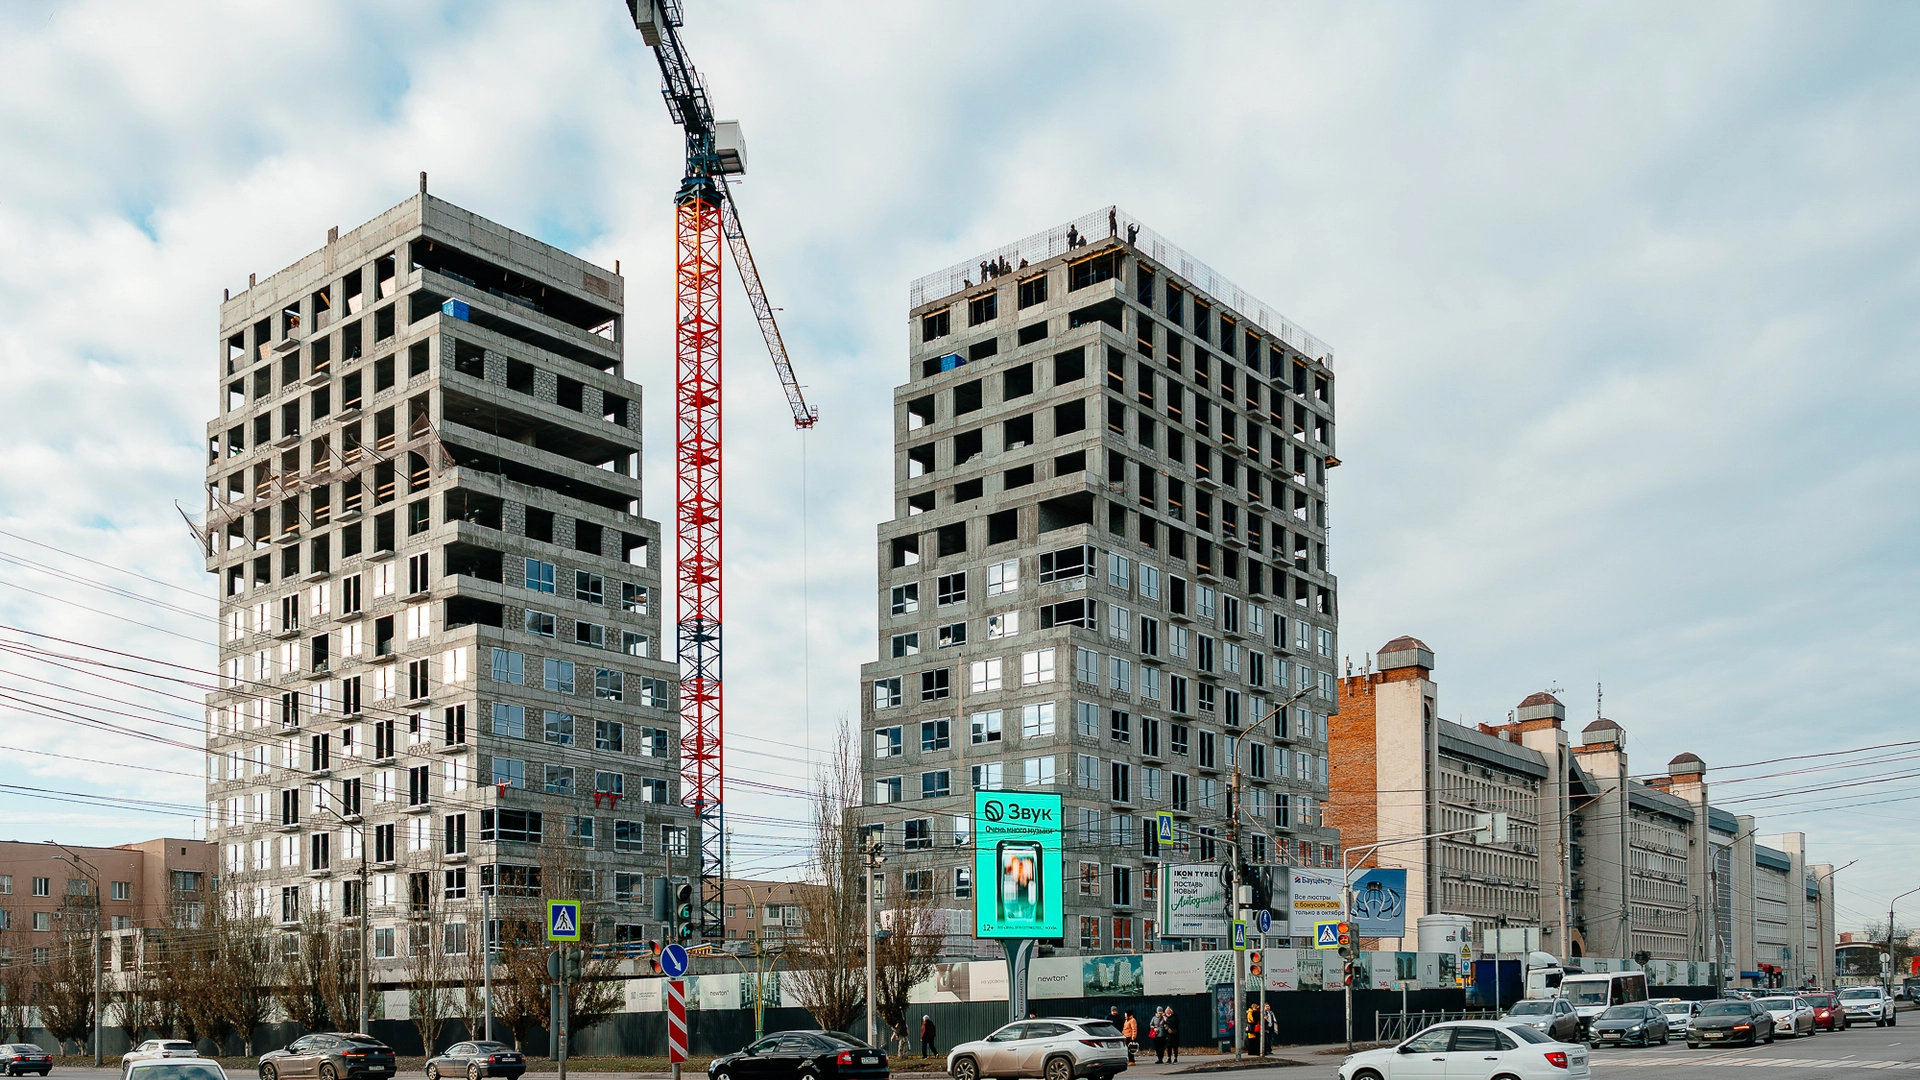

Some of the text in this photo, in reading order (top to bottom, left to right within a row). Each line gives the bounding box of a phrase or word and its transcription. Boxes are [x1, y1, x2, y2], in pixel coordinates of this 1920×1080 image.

[1008, 803, 1053, 823] Звук
[985, 825, 1006, 833] Очень
[1174, 880, 1204, 888] ПОСТАВЬ
[1301, 876, 1333, 885] Бауцентр
[1171, 891, 1220, 911] Autograph
[683, 906, 690, 918] 6
[983, 924, 994, 932] 12+
